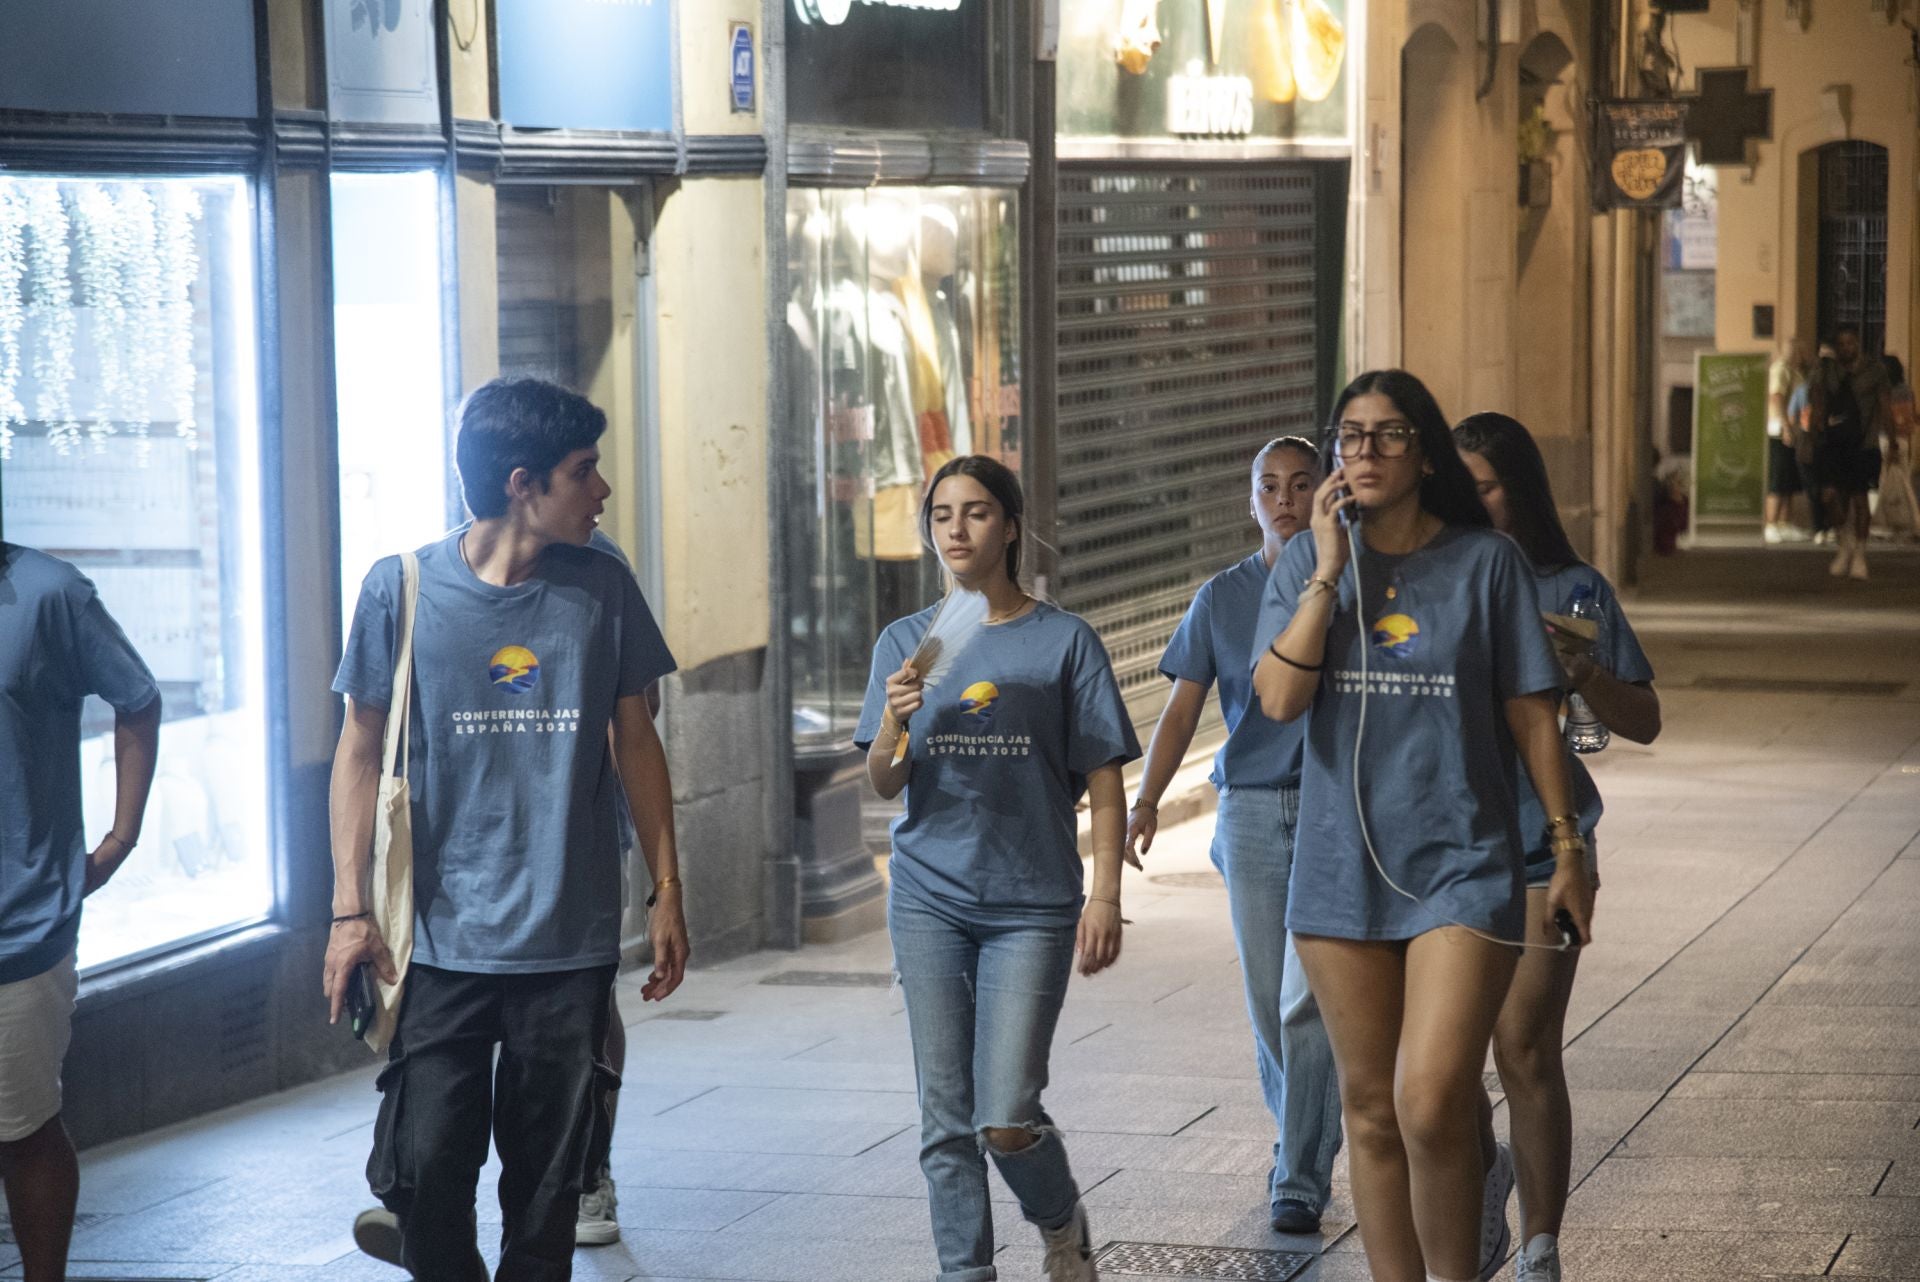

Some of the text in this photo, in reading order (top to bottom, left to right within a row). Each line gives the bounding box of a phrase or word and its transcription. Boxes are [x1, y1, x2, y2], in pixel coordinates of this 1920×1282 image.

[1334, 670, 1455, 686] CONERENCIA JAS
[1410, 685, 1452, 698] 2025
[452, 708, 580, 721] CONFERENCIA JAS
[455, 721, 577, 734] ESPAÑA 2025
[926, 734, 1031, 745] CONFERENCIA JAS
[929, 745, 1029, 756] ESPAÑA 2025
